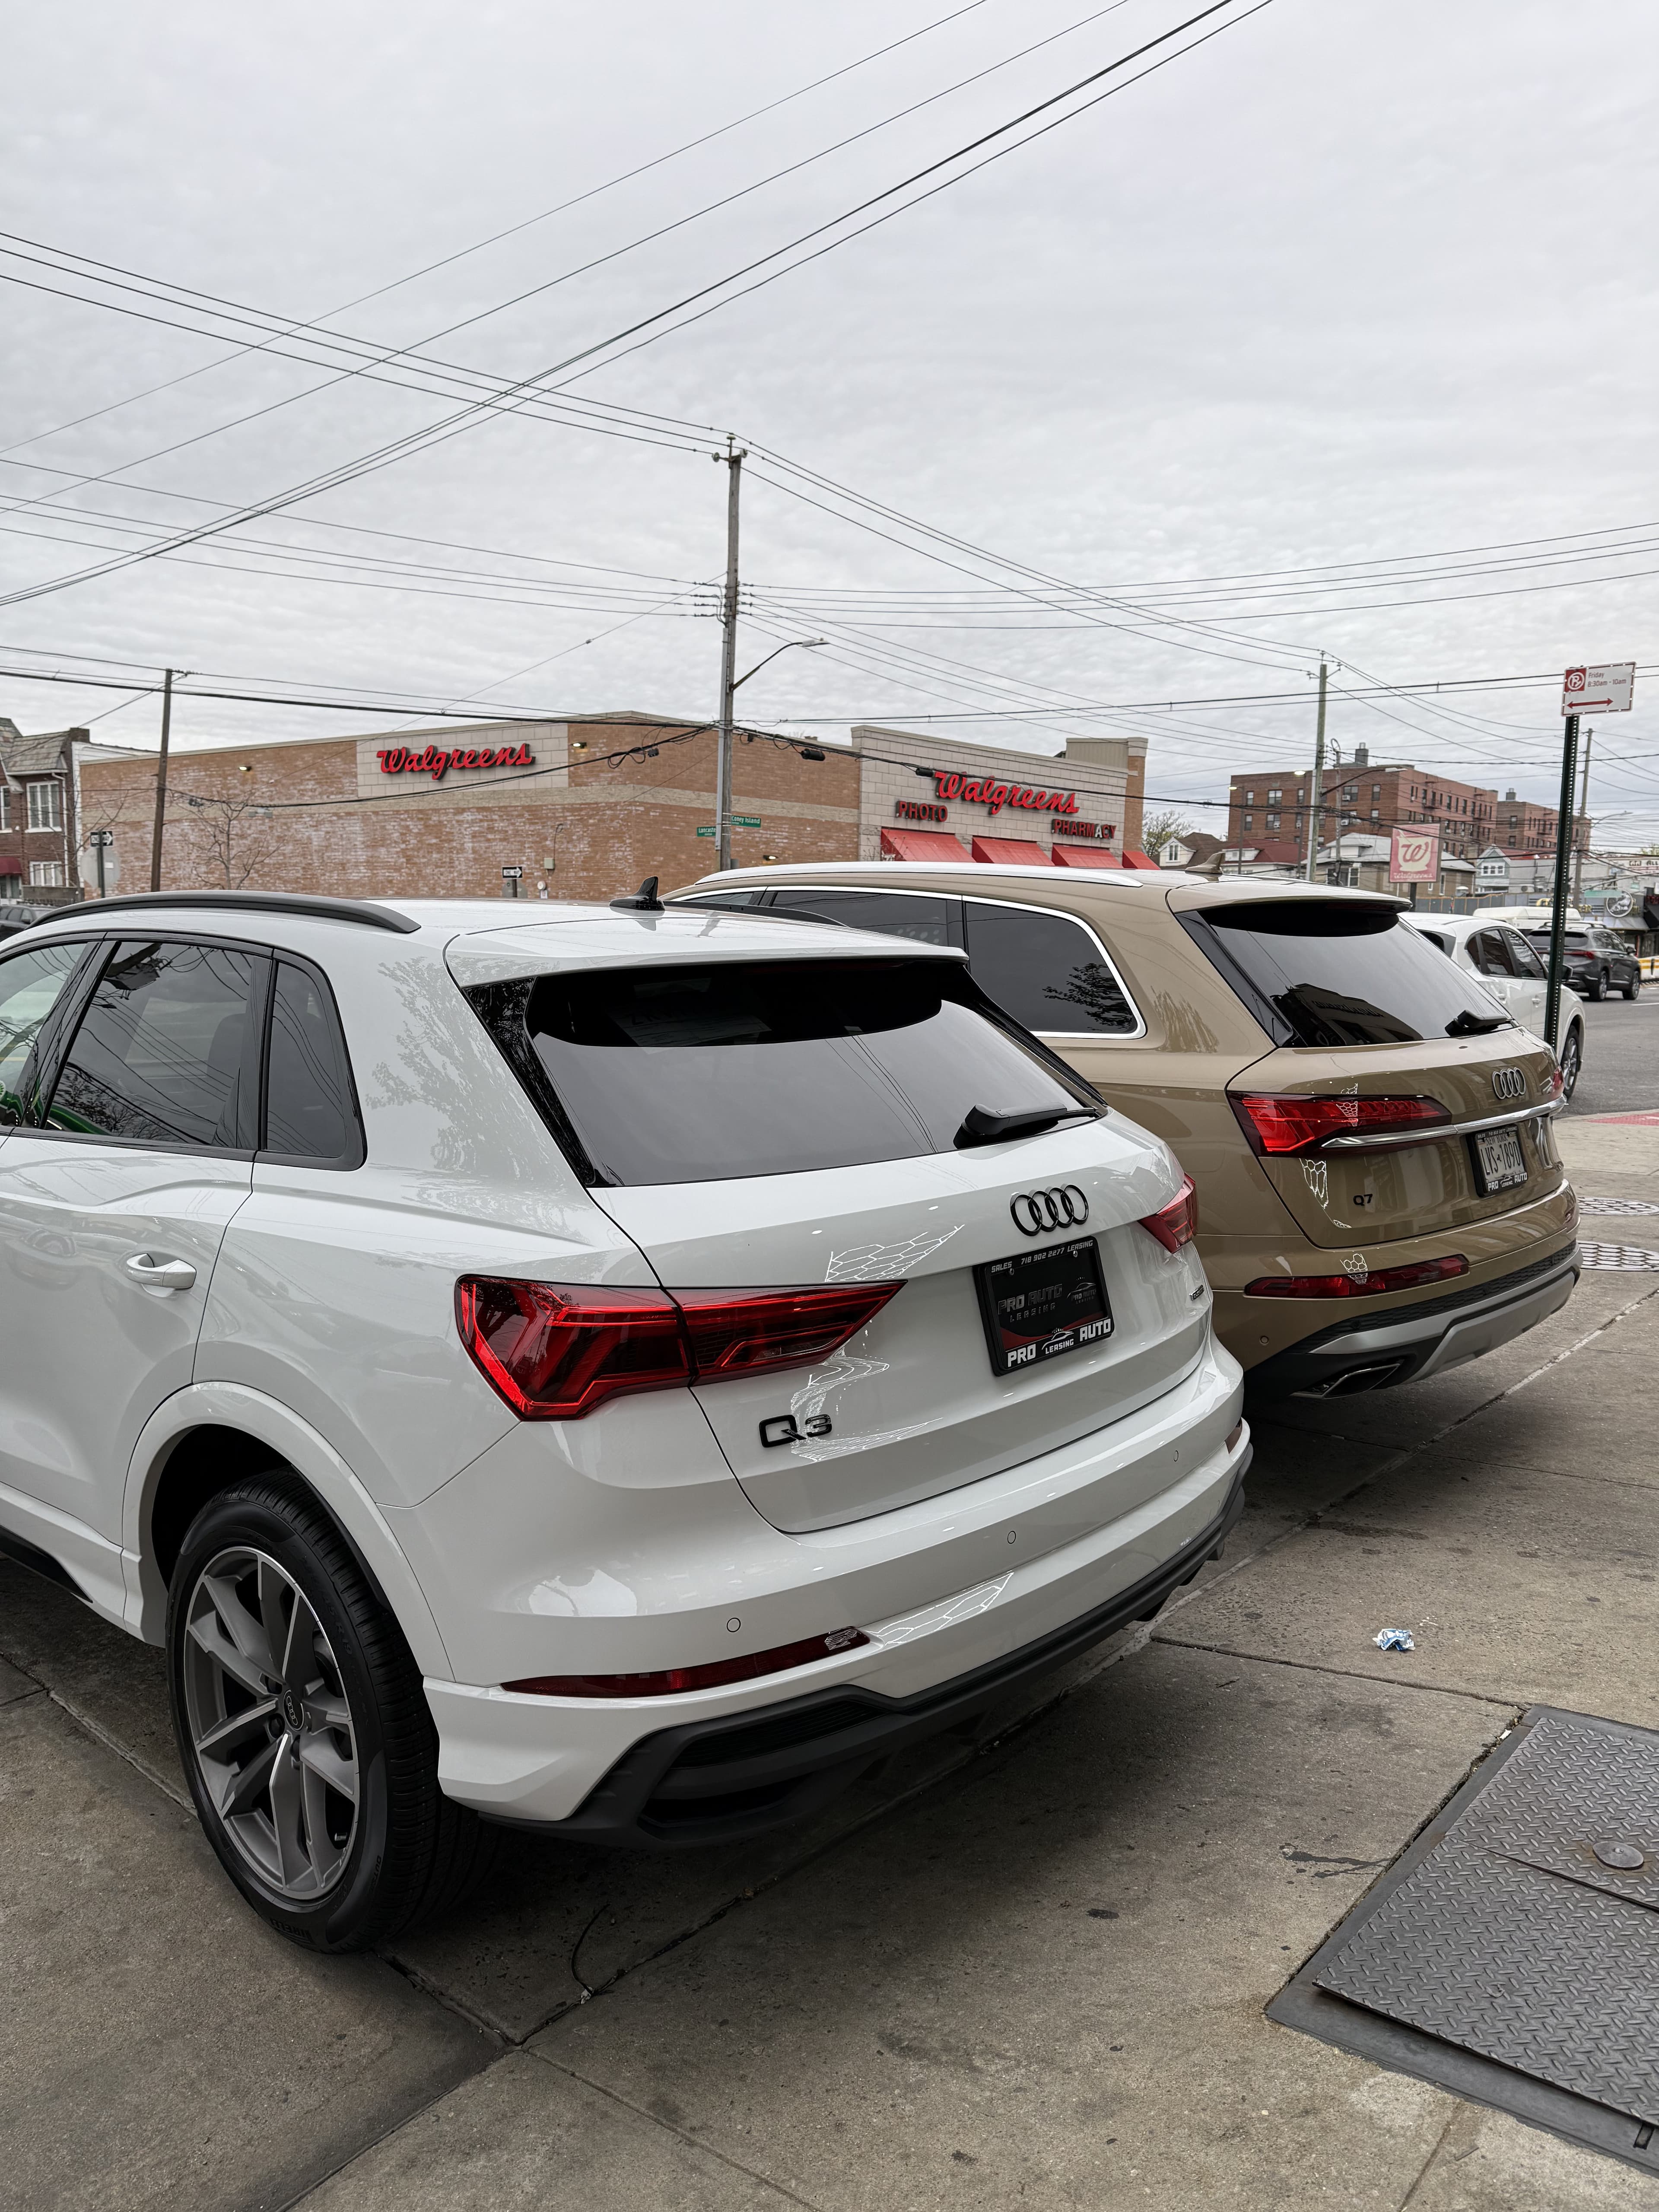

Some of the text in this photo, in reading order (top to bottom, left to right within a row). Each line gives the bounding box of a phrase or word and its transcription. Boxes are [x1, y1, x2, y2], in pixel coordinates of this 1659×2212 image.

[377, 743, 535, 780] Walgreens
[935, 772, 1079, 814] Walgreens
[898, 801, 947, 821] PHOTO
[1053, 819, 1117, 839] PHARMACY
[1486, 1135, 1496, 1146] NEW
[1487, 1181, 1498, 1191] PRO
[1514, 1172, 1527, 1183] AUTO
[1353, 1193, 1373, 1206] Q7
[991, 1240, 1093, 1273] SALES 718 902 2277 LEASING
[998, 1284, 1062, 1315] PRO AUTO
[1010, 1303, 1056, 1323] LEASING
[1007, 1319, 1111, 1367] PRO LEASING AUTO
[759, 1414, 832, 1448] Q3
